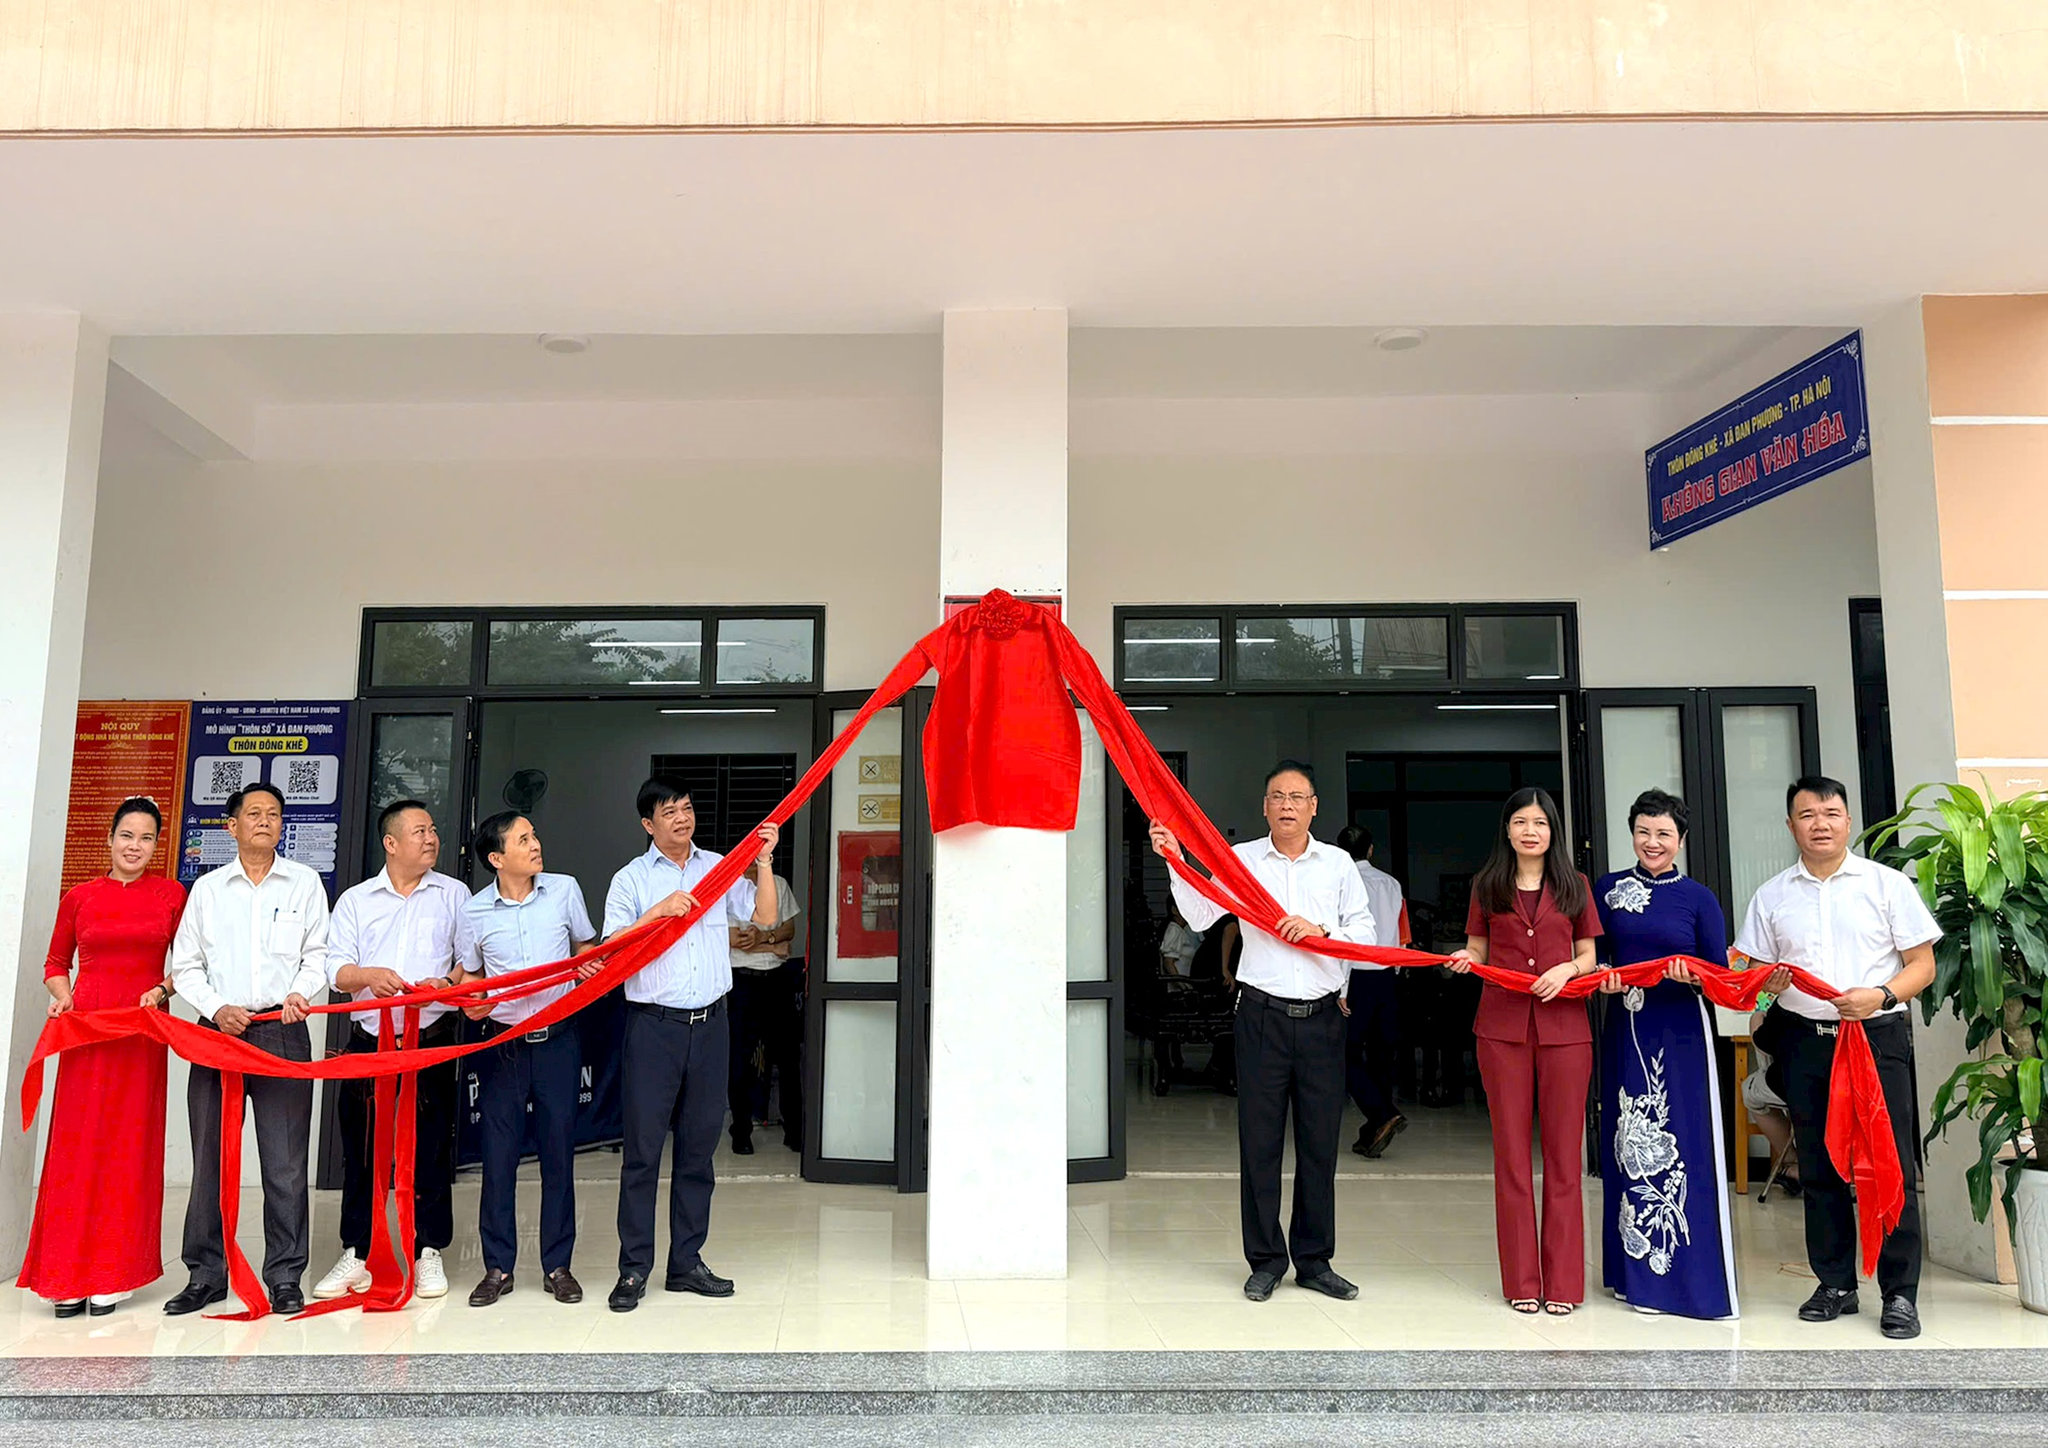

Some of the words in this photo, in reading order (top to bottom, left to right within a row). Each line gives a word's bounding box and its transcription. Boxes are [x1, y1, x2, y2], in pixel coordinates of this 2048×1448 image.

[1667, 455, 1684, 476] THÔN
[1704, 434, 1718, 458] KHÊ
[1723, 426, 1735, 448] XÃ
[1735, 421, 1751, 443] ĐAN
[1751, 402, 1783, 433] PHƯỢNG
[1789, 393, 1802, 413] TP.
[1802, 383, 1815, 407] HÀ
[1815, 374, 1832, 400] NỘI
[1661, 474, 1716, 524] KHÔNG
[1718, 453, 1758, 496] GIAN
[1760, 433, 1799, 475] VĂN
[1802, 411, 1847, 458] HÓA
[101, 721, 117, 732] NỘI
[119, 722, 140, 731] QUY
[205, 723, 217, 734] MÔ
[218, 724, 236, 734] HÌNH
[276, 723, 286, 734] XÃ
[287, 724, 303, 734] ĐAN
[304, 723, 333, 736] PHƯỢNG
[233, 739, 256, 750] THÔN
[285, 739, 303, 750] KHÊ
